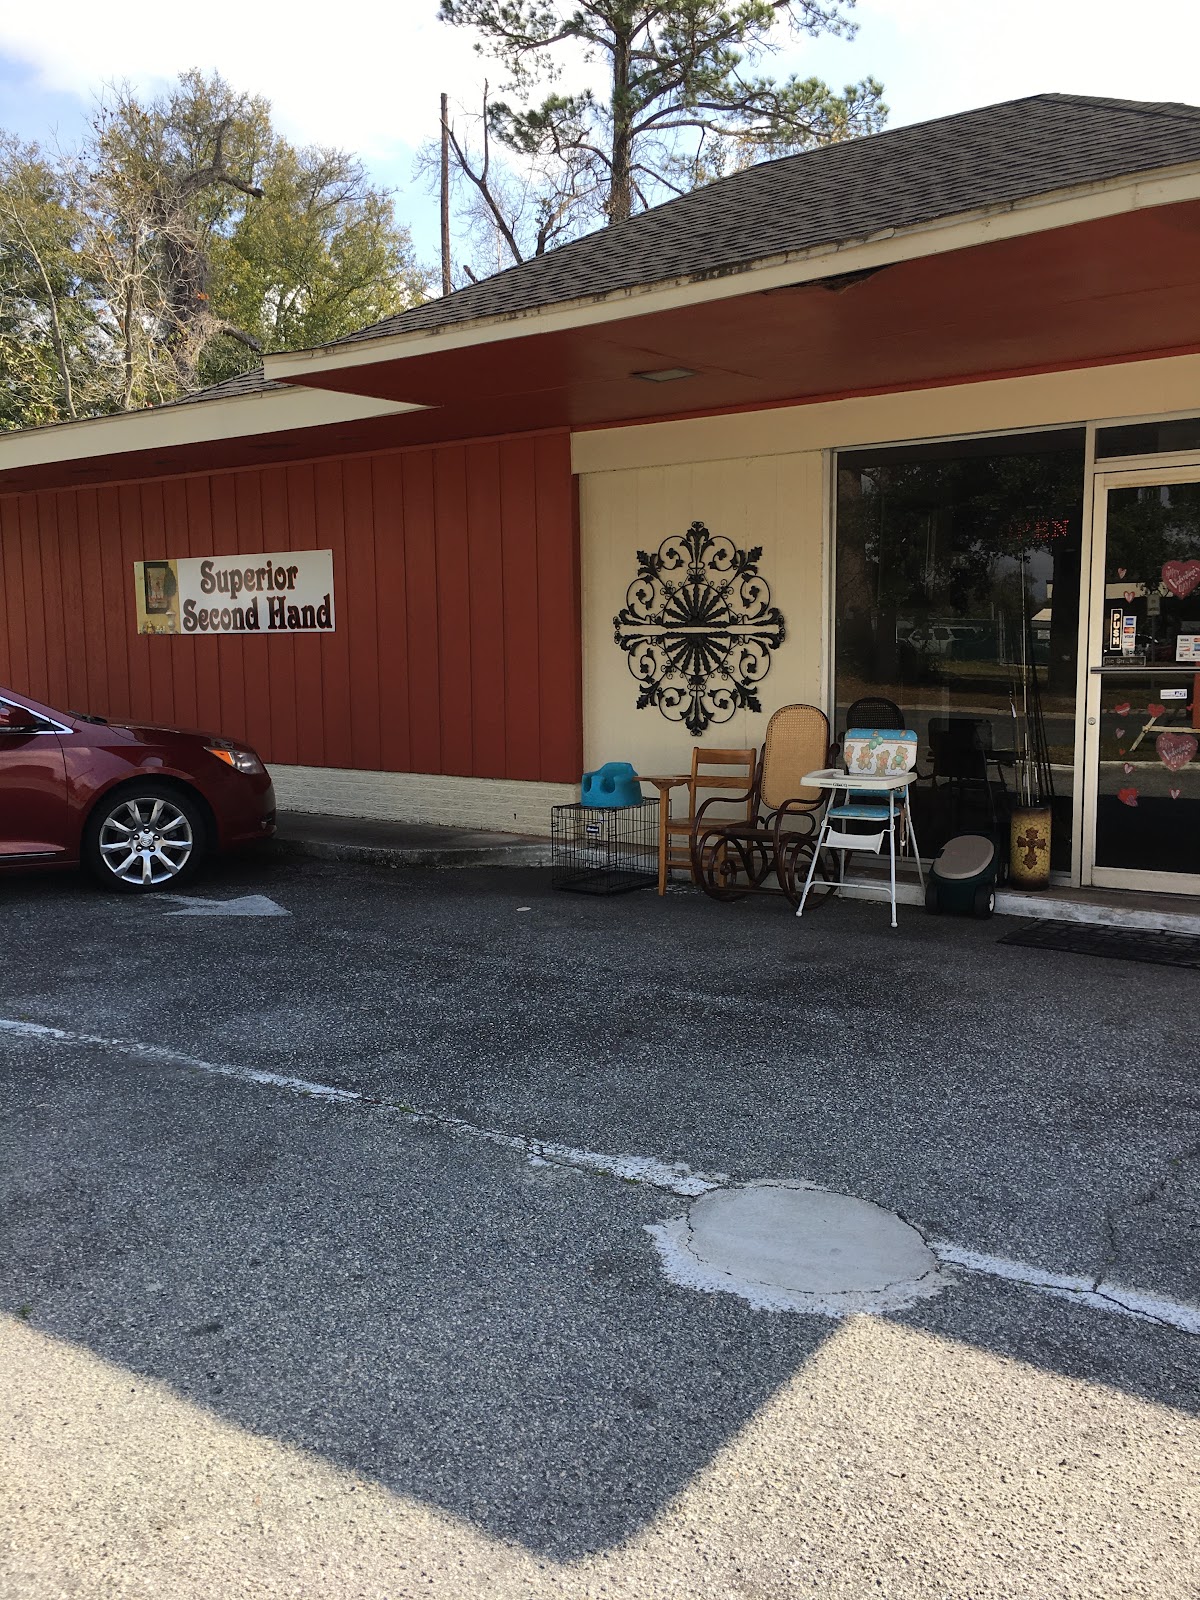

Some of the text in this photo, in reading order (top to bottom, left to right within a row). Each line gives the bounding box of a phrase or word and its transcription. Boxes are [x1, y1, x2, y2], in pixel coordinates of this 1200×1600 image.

[1006, 518, 1070, 538] PEN
[201, 560, 298, 599] Superior
[183, 593, 332, 631] Second Hand
[1112, 613, 1120, 645] PUSH
